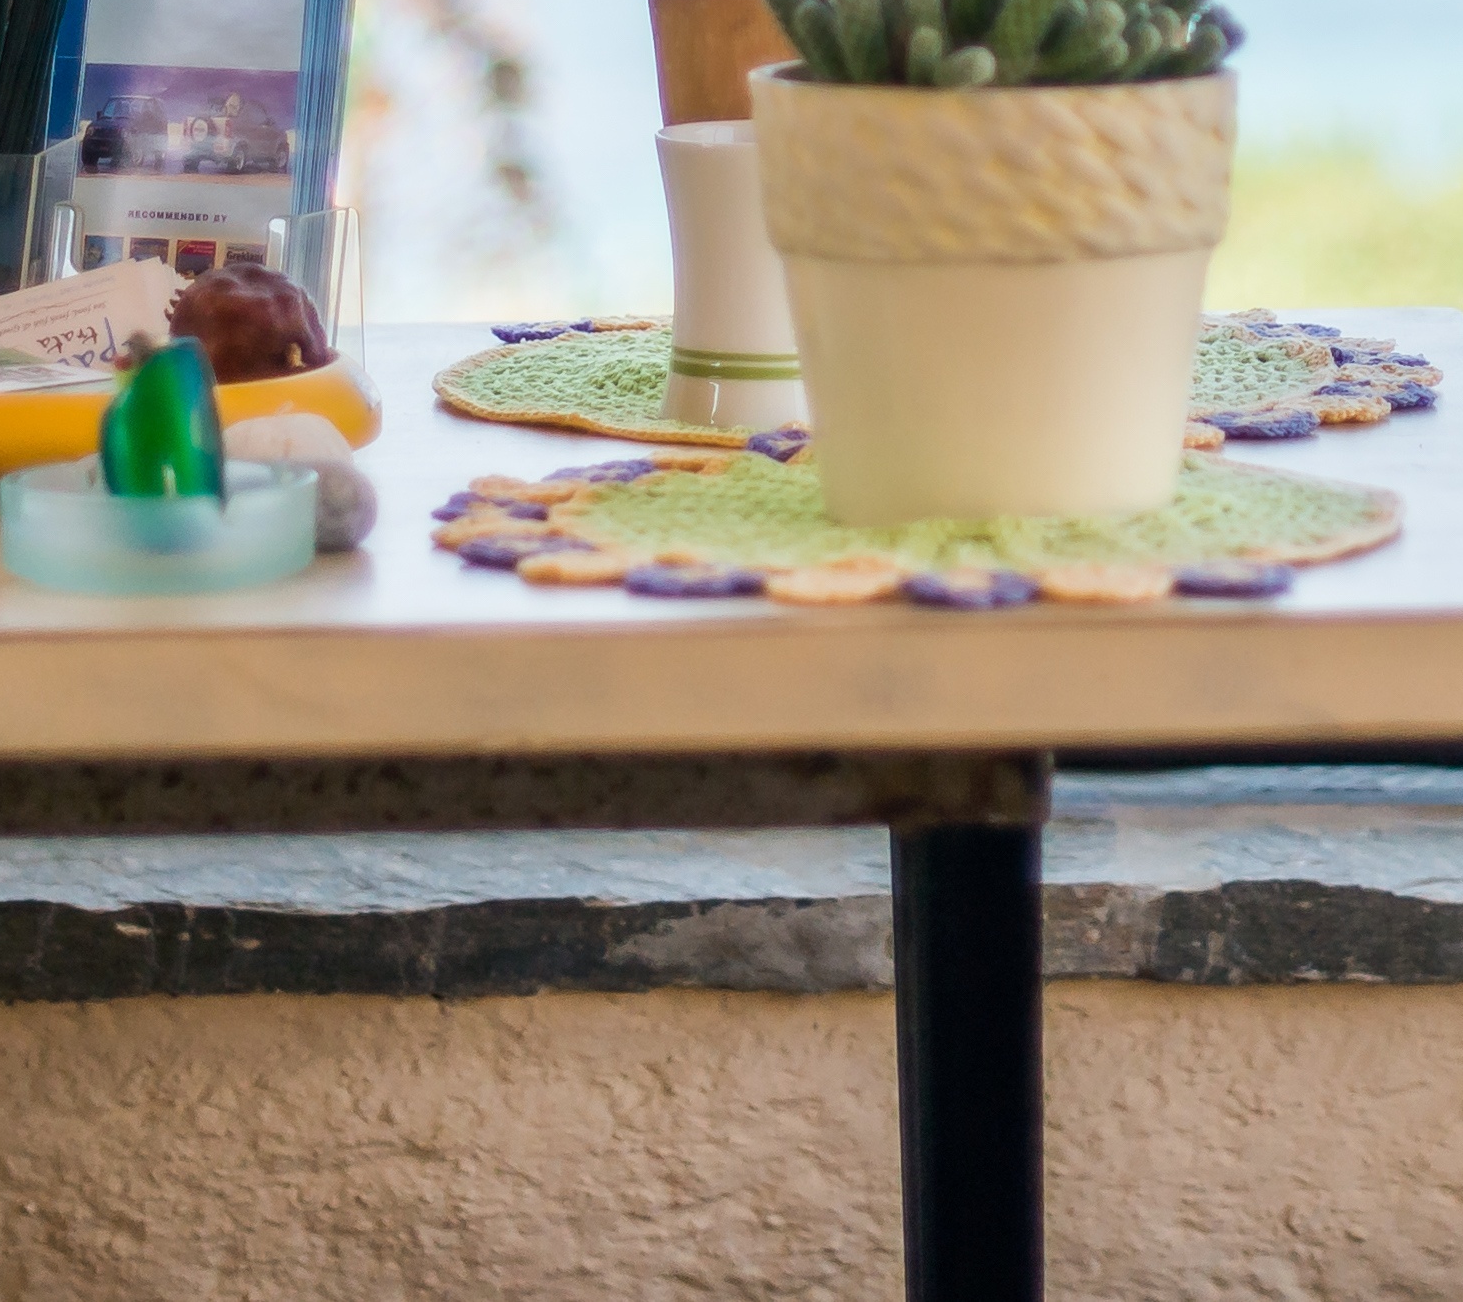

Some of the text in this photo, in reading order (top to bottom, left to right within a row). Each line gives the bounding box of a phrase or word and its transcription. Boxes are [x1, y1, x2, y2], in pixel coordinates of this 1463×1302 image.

[127, 210, 228, 224] RECOMMENDED BY
[36, 326, 98, 355] trata
